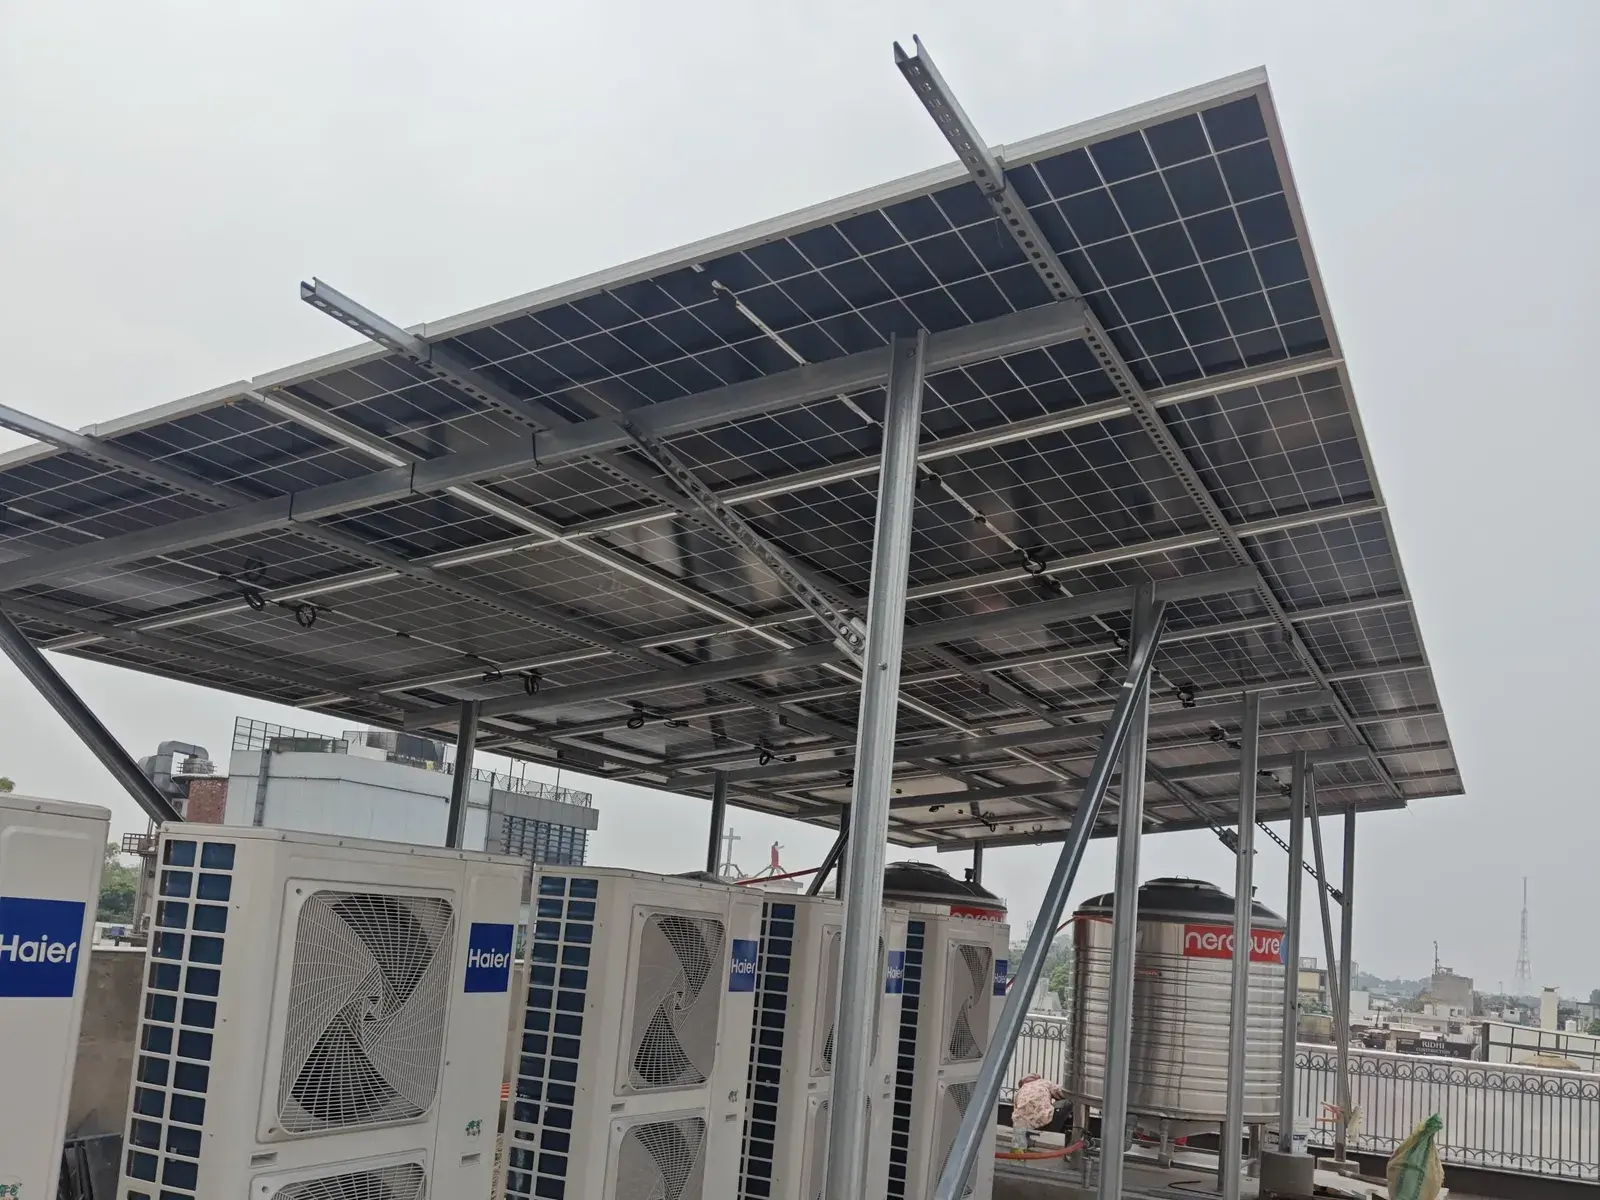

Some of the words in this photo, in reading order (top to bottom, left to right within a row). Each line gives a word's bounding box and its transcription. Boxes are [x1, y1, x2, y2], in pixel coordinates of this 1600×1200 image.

[0, 934, 77, 963] Haier
[468, 948, 510, 968] Haier
[731, 958, 756, 974] Haier
[887, 966, 904, 979] Haier
[1422, 1040, 1445, 1049] RIDHI
